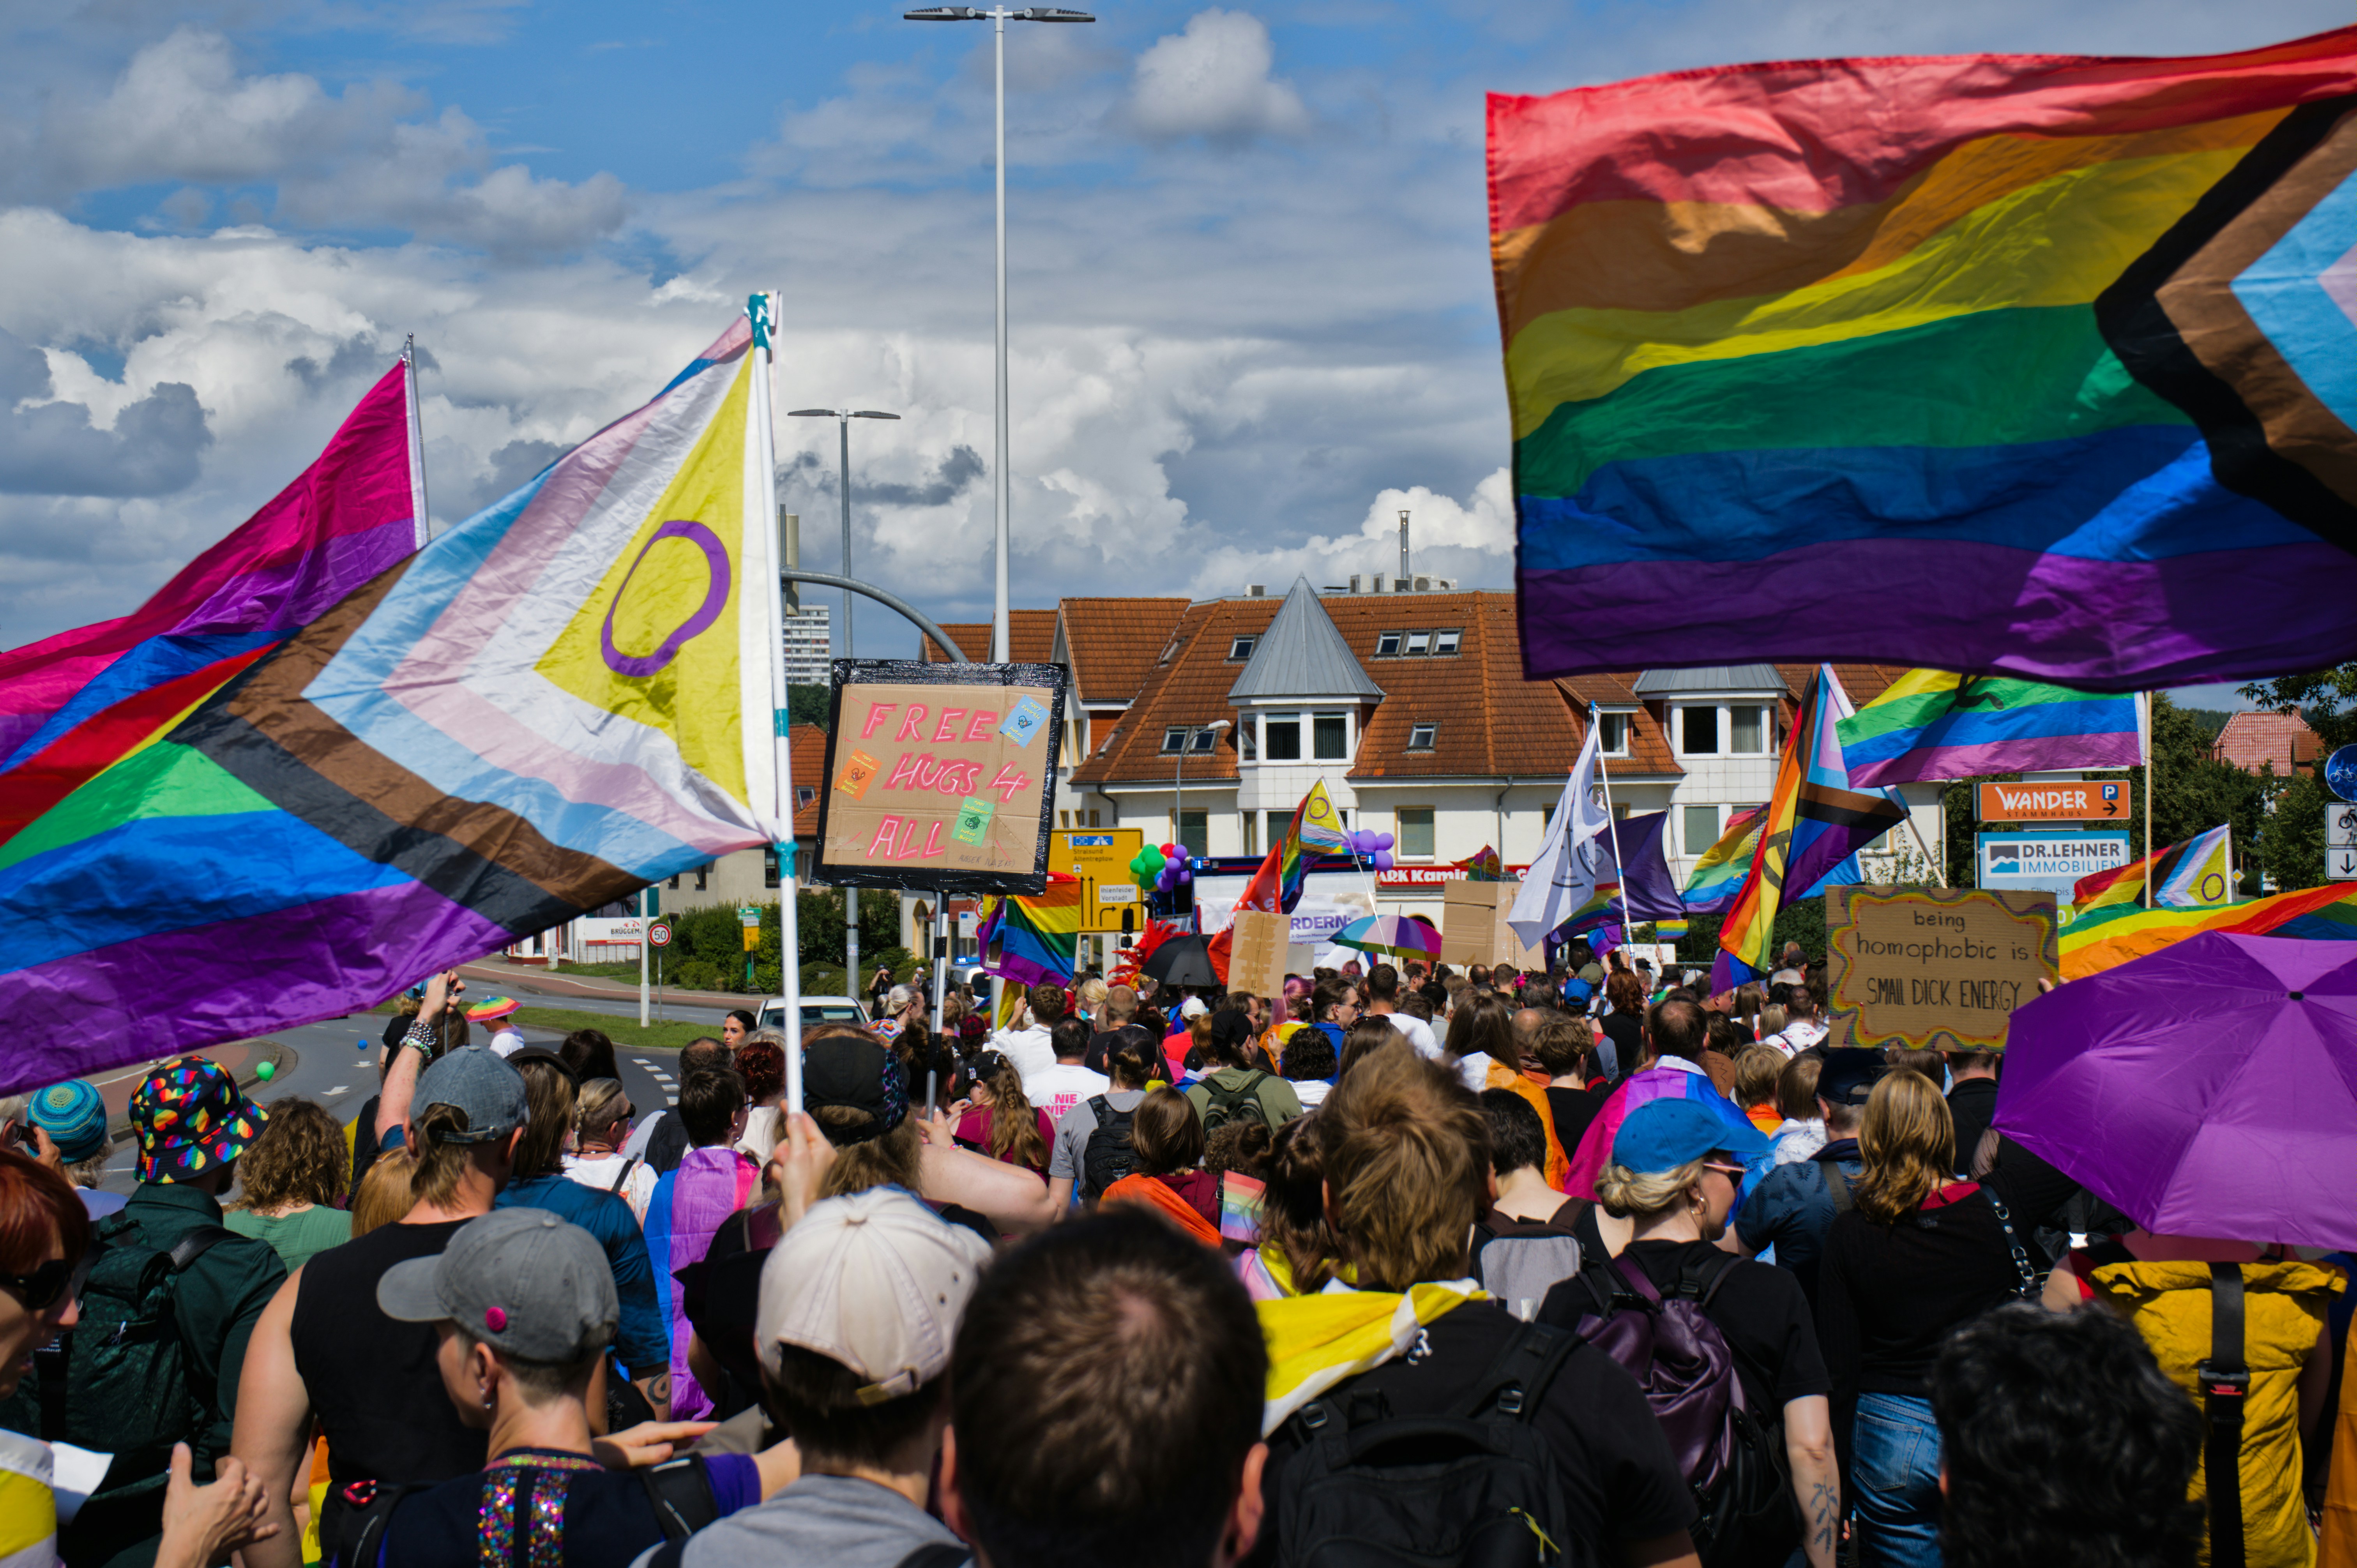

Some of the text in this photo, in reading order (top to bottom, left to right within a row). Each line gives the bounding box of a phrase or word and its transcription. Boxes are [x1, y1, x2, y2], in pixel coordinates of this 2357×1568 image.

[1021, 705, 1041, 719] Squirtle
[860, 703, 998, 743] FREE
[1006, 731, 1019, 743] Nazis
[1009, 726, 1023, 738] hates
[852, 756, 876, 771] Charmander
[844, 779, 859, 789] hates
[882, 752, 1034, 804] HUGS 4
[841, 785, 855, 795] Nazis
[1995, 786, 2088, 810] WANDER
[964, 804, 990, 815] Bulbasaur
[866, 814, 946, 860] ALL
[958, 834, 974, 843] Nazis
[960, 828, 976, 837] hates
[2023, 843, 2120, 858] DR.LEHNER
[958, 854, 982, 864] AUSSER
[2023, 860, 2121, 873] IMMOBILIEN
[1372, 870, 1409, 882] ARK
[2055, 887, 2069, 896] bis
[1914, 911, 1965, 933] being
[654, 930, 666, 940] 50
[1856, 932, 2029, 964] homophobic is
[1912, 978, 1951, 1006] DICK
[1960, 980, 2023, 1011] ENERGY
[1055, 1094, 1077, 1104] NIE
